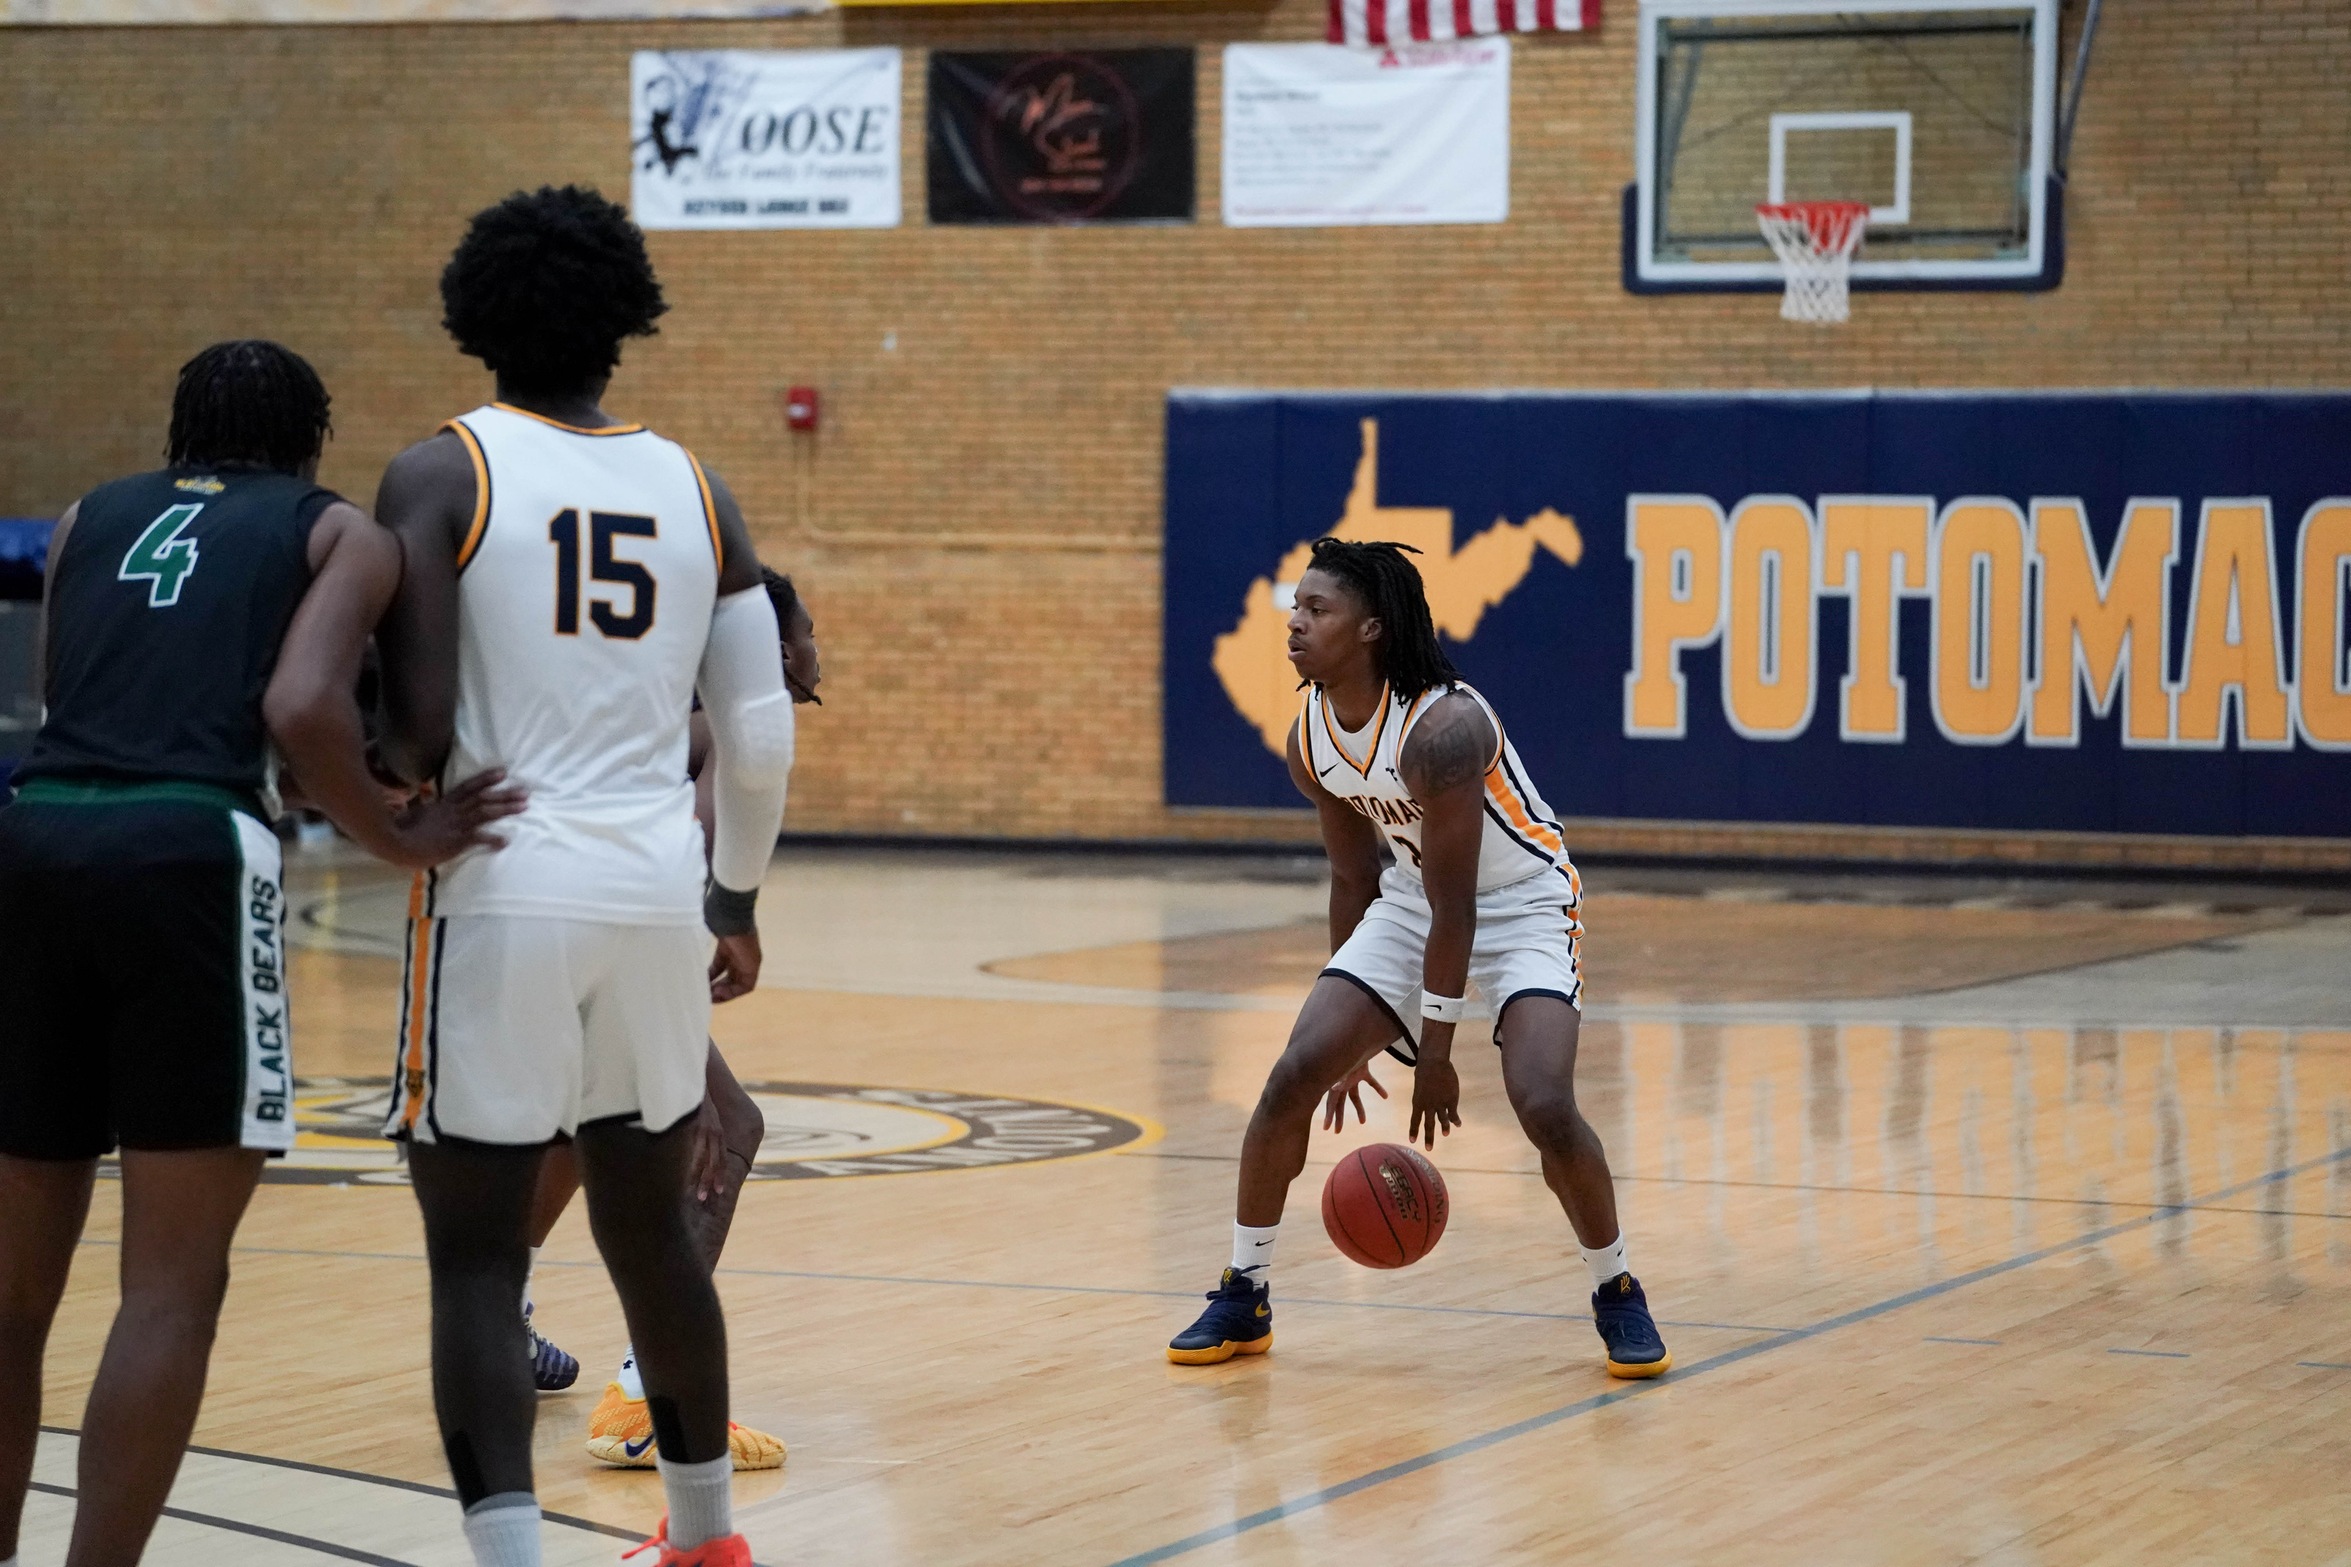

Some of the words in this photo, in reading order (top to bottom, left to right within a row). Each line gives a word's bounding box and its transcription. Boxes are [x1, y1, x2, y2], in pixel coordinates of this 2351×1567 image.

[117, 503, 205, 608] 4
[549, 508, 658, 641] 15
[1624, 494, 2351, 751] POTOMAC
[251, 875, 279, 994] BEARS
[255, 1004, 287, 1122] BLACK
